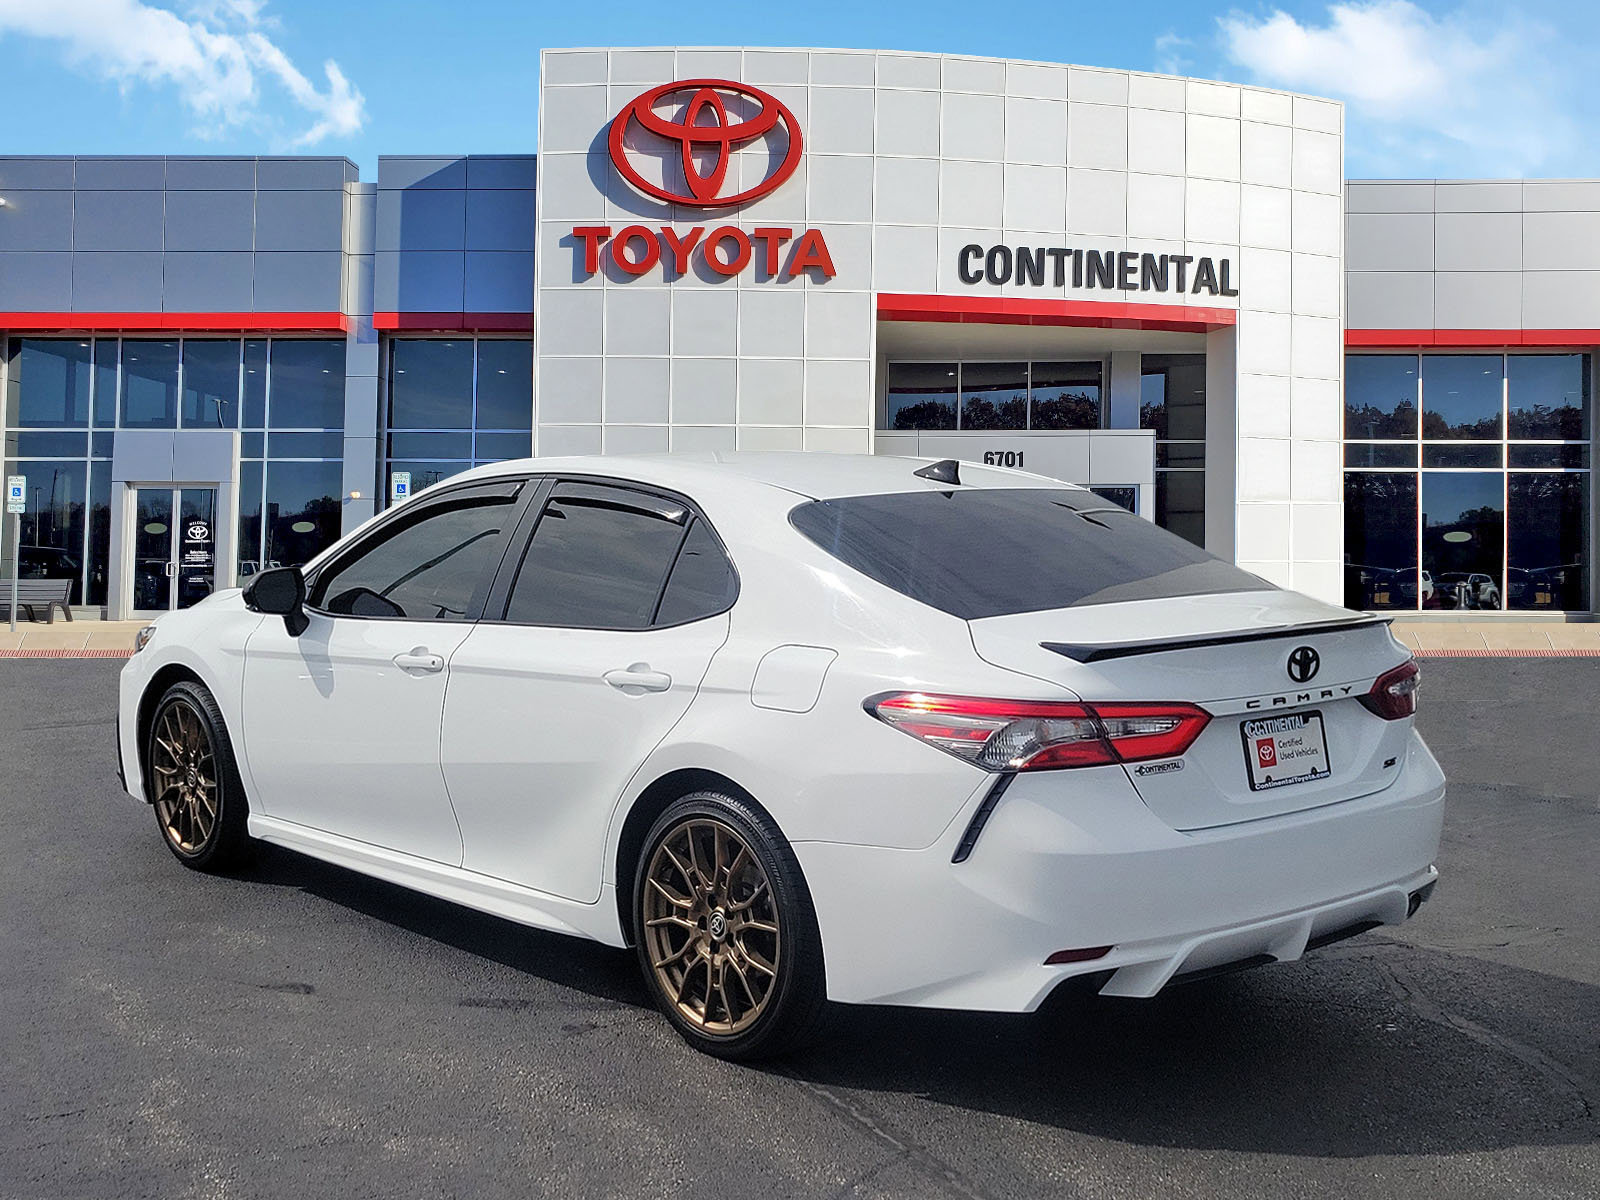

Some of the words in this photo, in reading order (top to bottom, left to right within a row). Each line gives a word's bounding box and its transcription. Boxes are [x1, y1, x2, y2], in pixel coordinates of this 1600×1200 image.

[573, 225, 837, 277] TOYOTA
[958, 244, 1239, 297] CONTINENTAL
[983, 451, 1024, 467] 6701
[1246, 686, 1352, 709] CAMRY
[1244, 715, 1306, 738] CONTINENTAL
[1278, 737, 1303, 749] Certified
[1280, 751, 1295, 761] Used
[1295, 747, 1319, 759] Vehicles
[1254, 771, 1330, 790] ContinentalToyota.com
